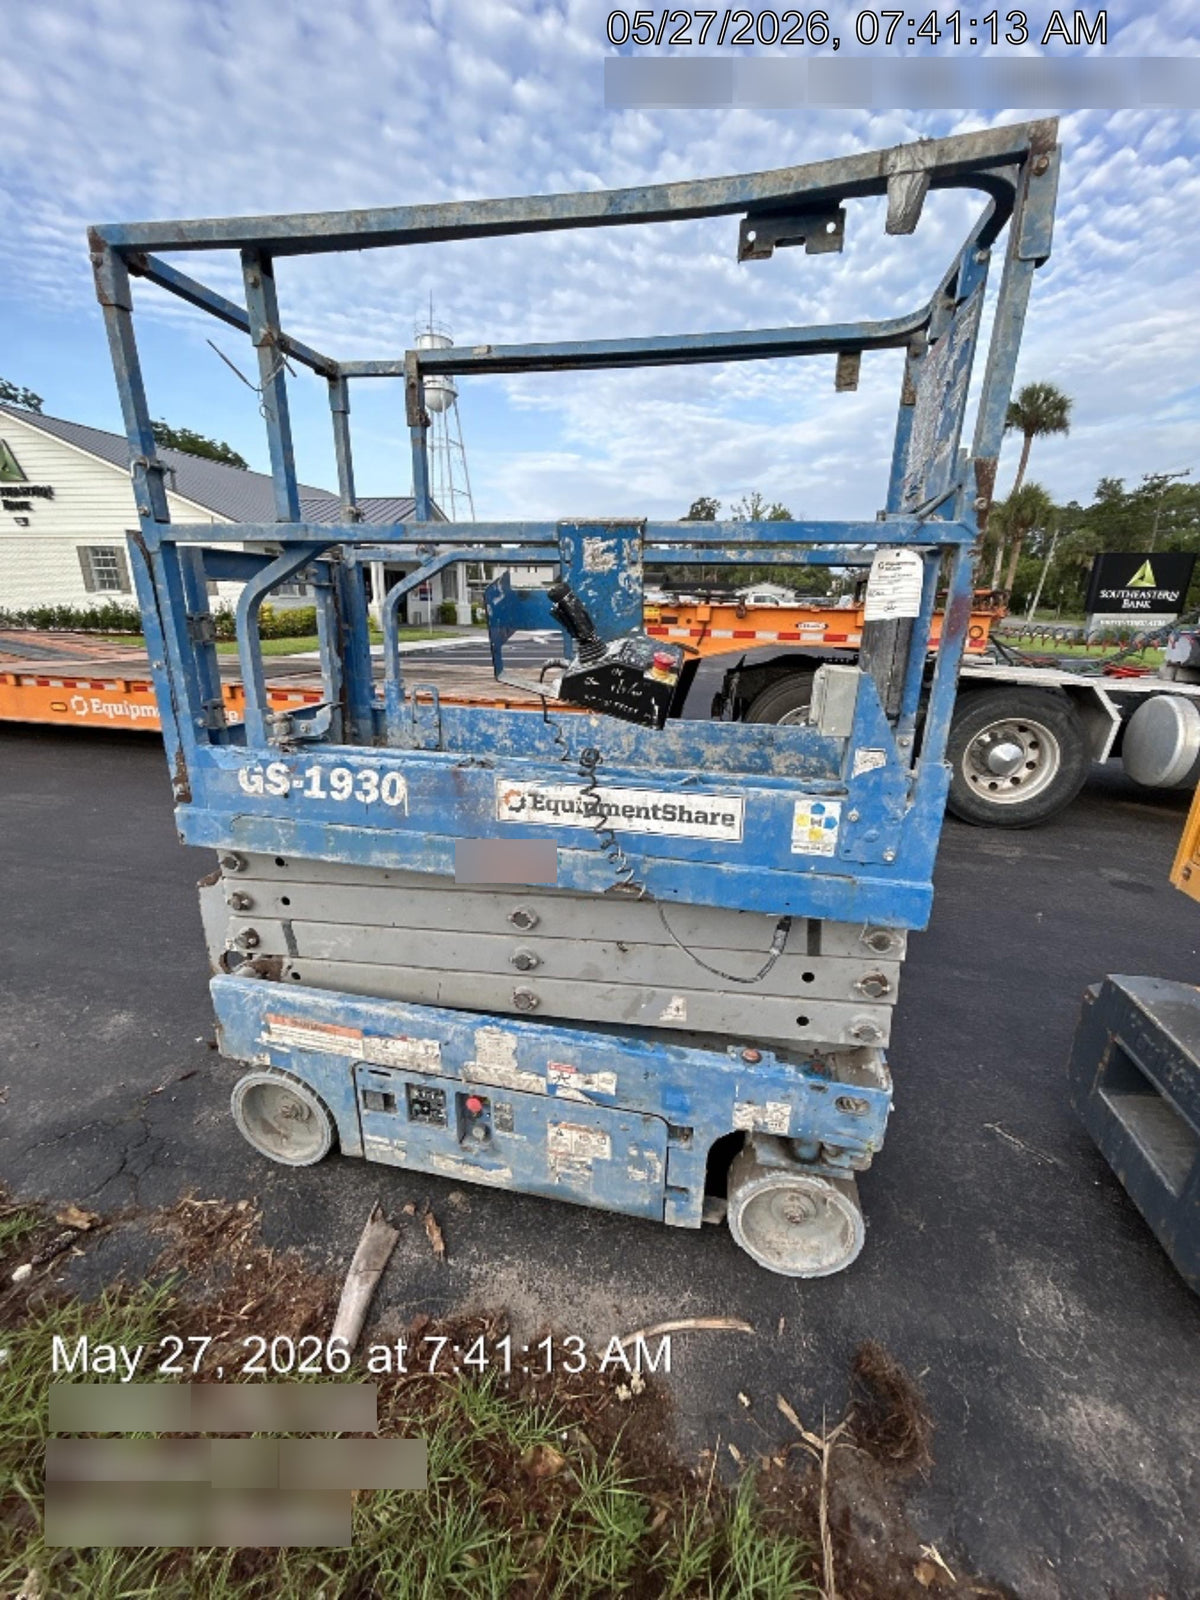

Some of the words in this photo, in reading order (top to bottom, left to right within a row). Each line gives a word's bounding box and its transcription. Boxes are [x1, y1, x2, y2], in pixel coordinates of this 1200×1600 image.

[1099, 589, 1180, 602] SOUTHEASTERN
[1121, 599, 1151, 609] BANK
[237, 762, 409, 806] GS-1930
